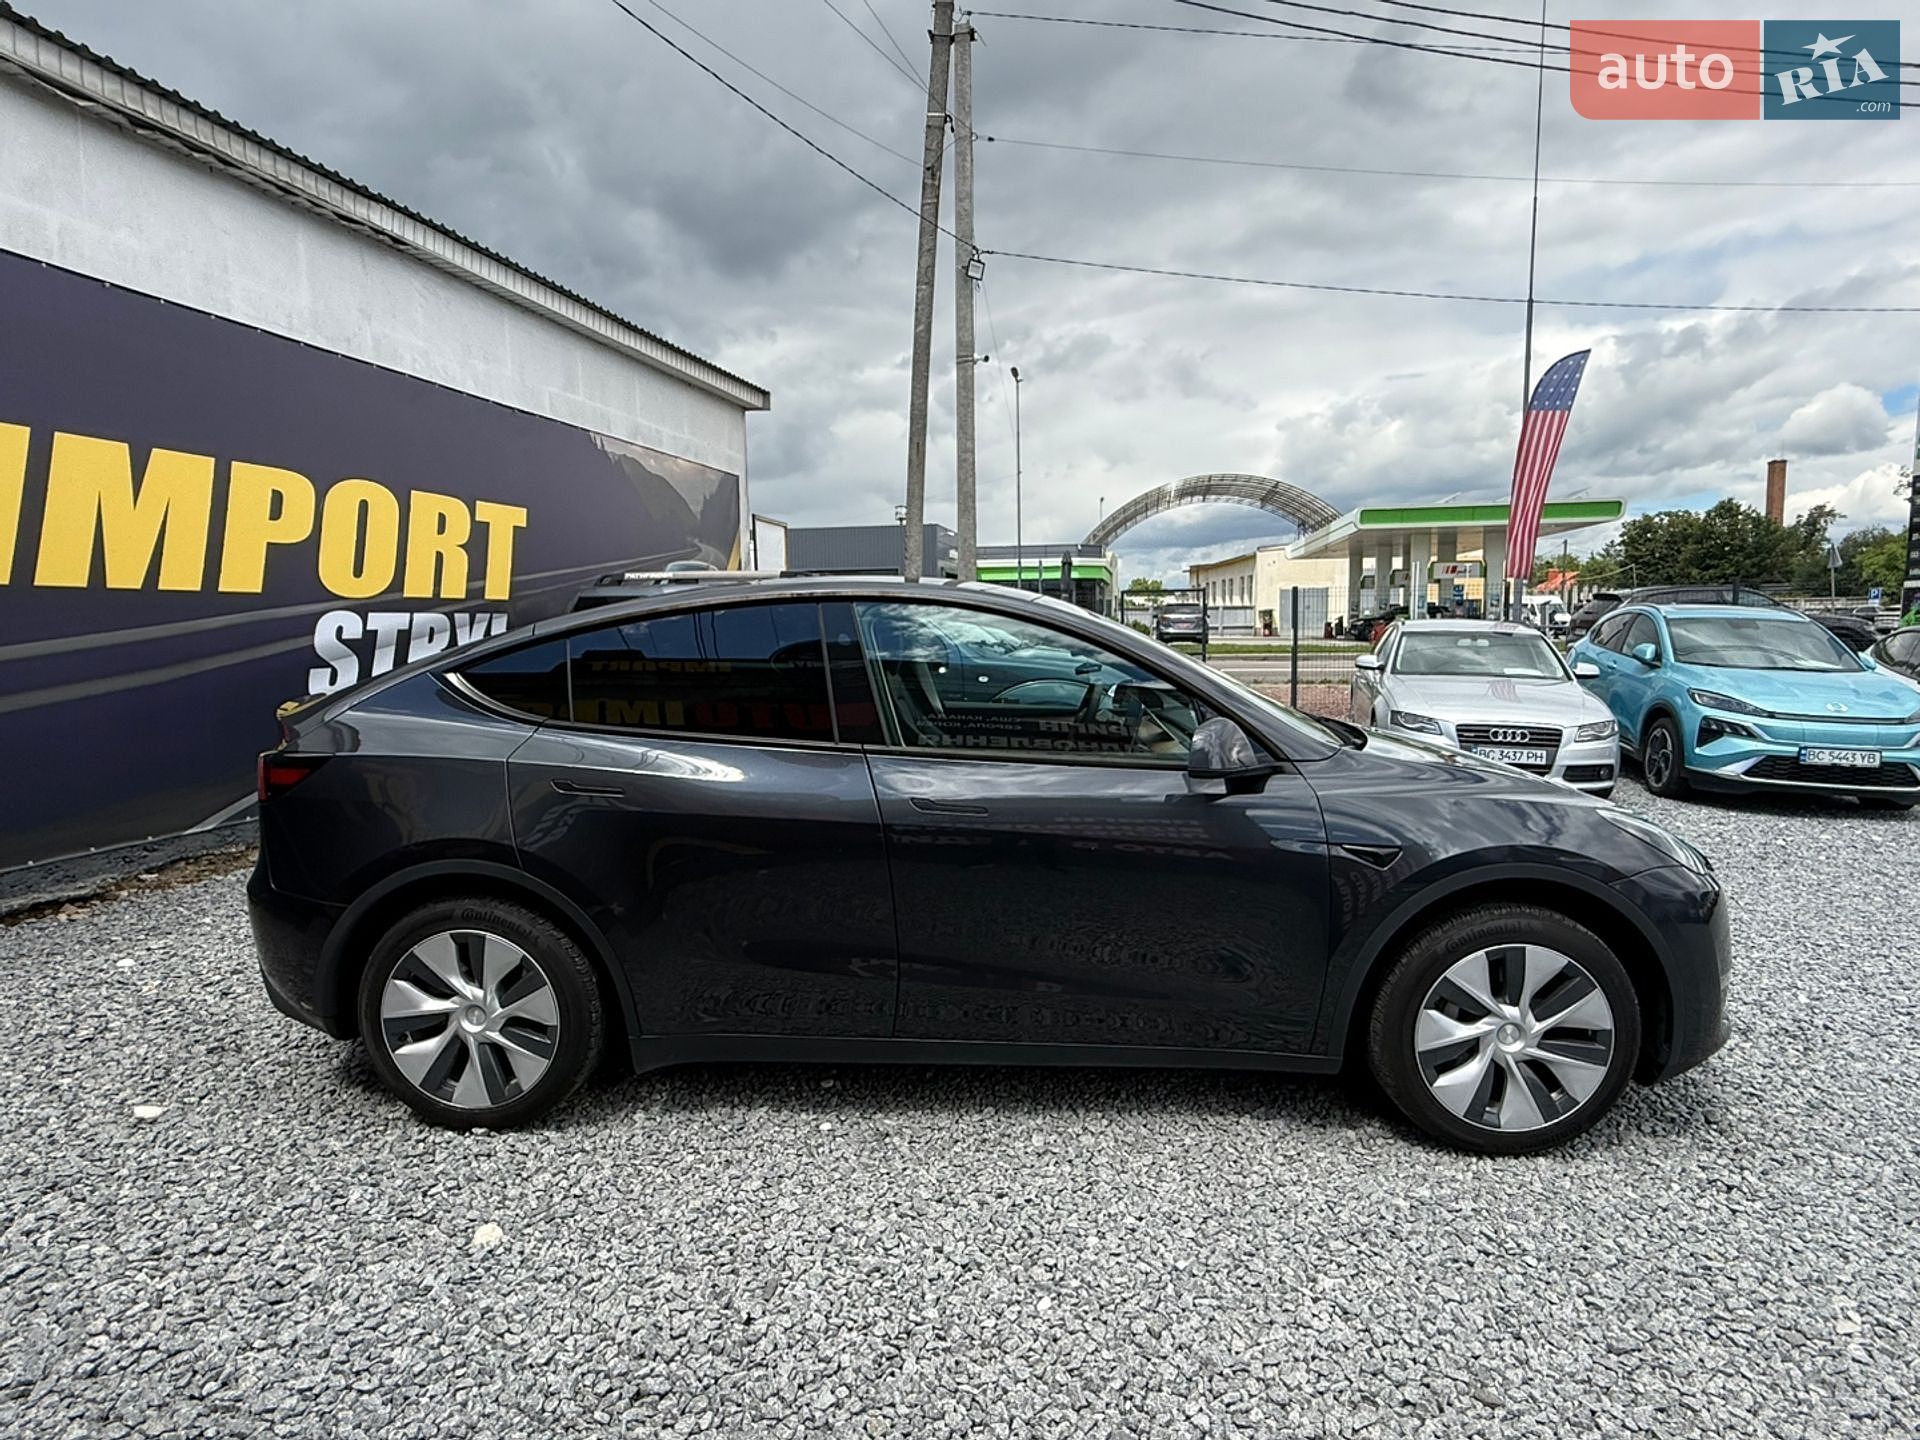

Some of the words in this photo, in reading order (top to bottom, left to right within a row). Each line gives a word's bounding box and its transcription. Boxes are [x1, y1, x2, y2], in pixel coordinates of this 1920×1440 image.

[308, 610, 509, 696] STRY
[1498, 750, 1524, 761] 3437
[1526, 751, 1544, 762] PH
[1807, 750, 1825, 761] BC
[1828, 750, 1857, 762] 5443
